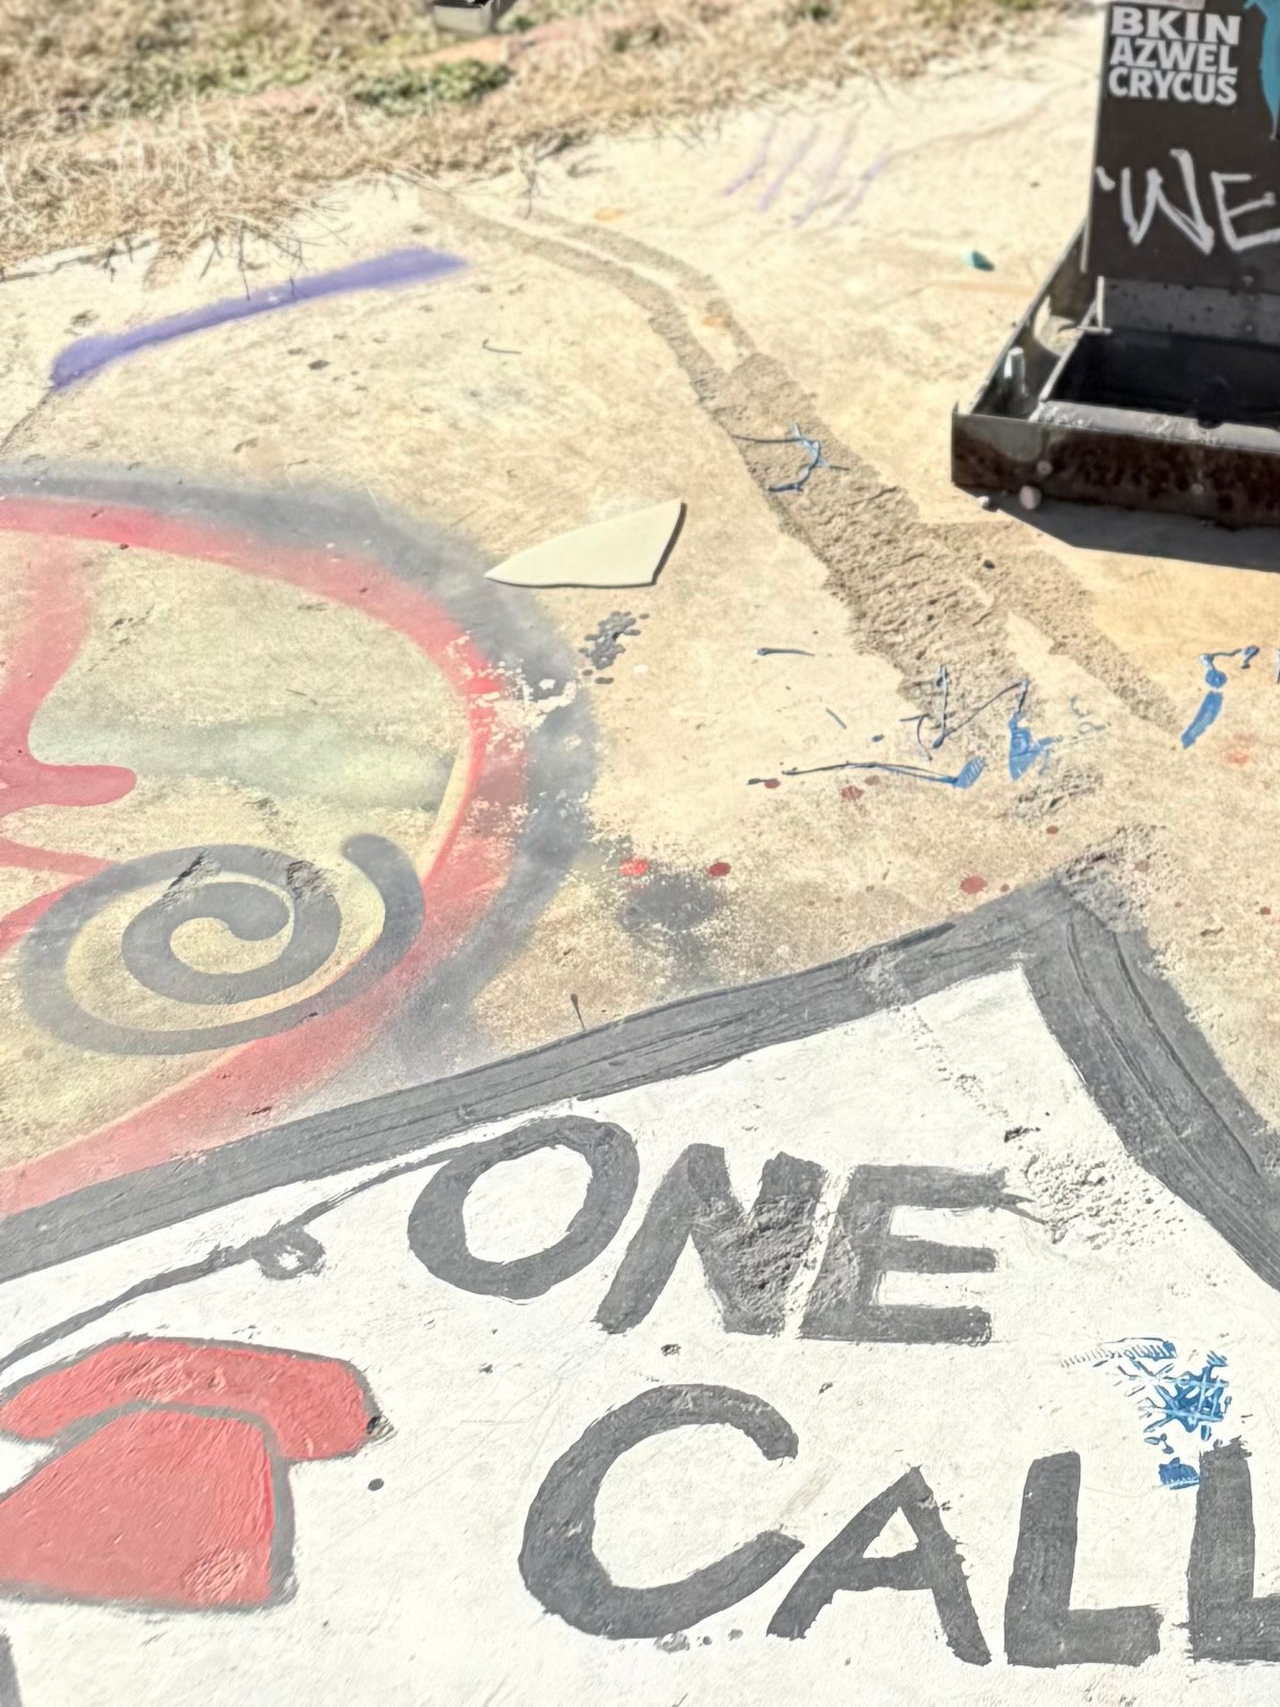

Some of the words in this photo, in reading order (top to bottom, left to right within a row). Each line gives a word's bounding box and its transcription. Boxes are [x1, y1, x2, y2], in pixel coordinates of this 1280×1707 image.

[1111, 6, 1241, 45] BKIN
[1110, 36, 1239, 76] AZWEL
[1109, 66, 1238, 106] CRYCUS
[407, 1113, 1003, 1345] ONE
